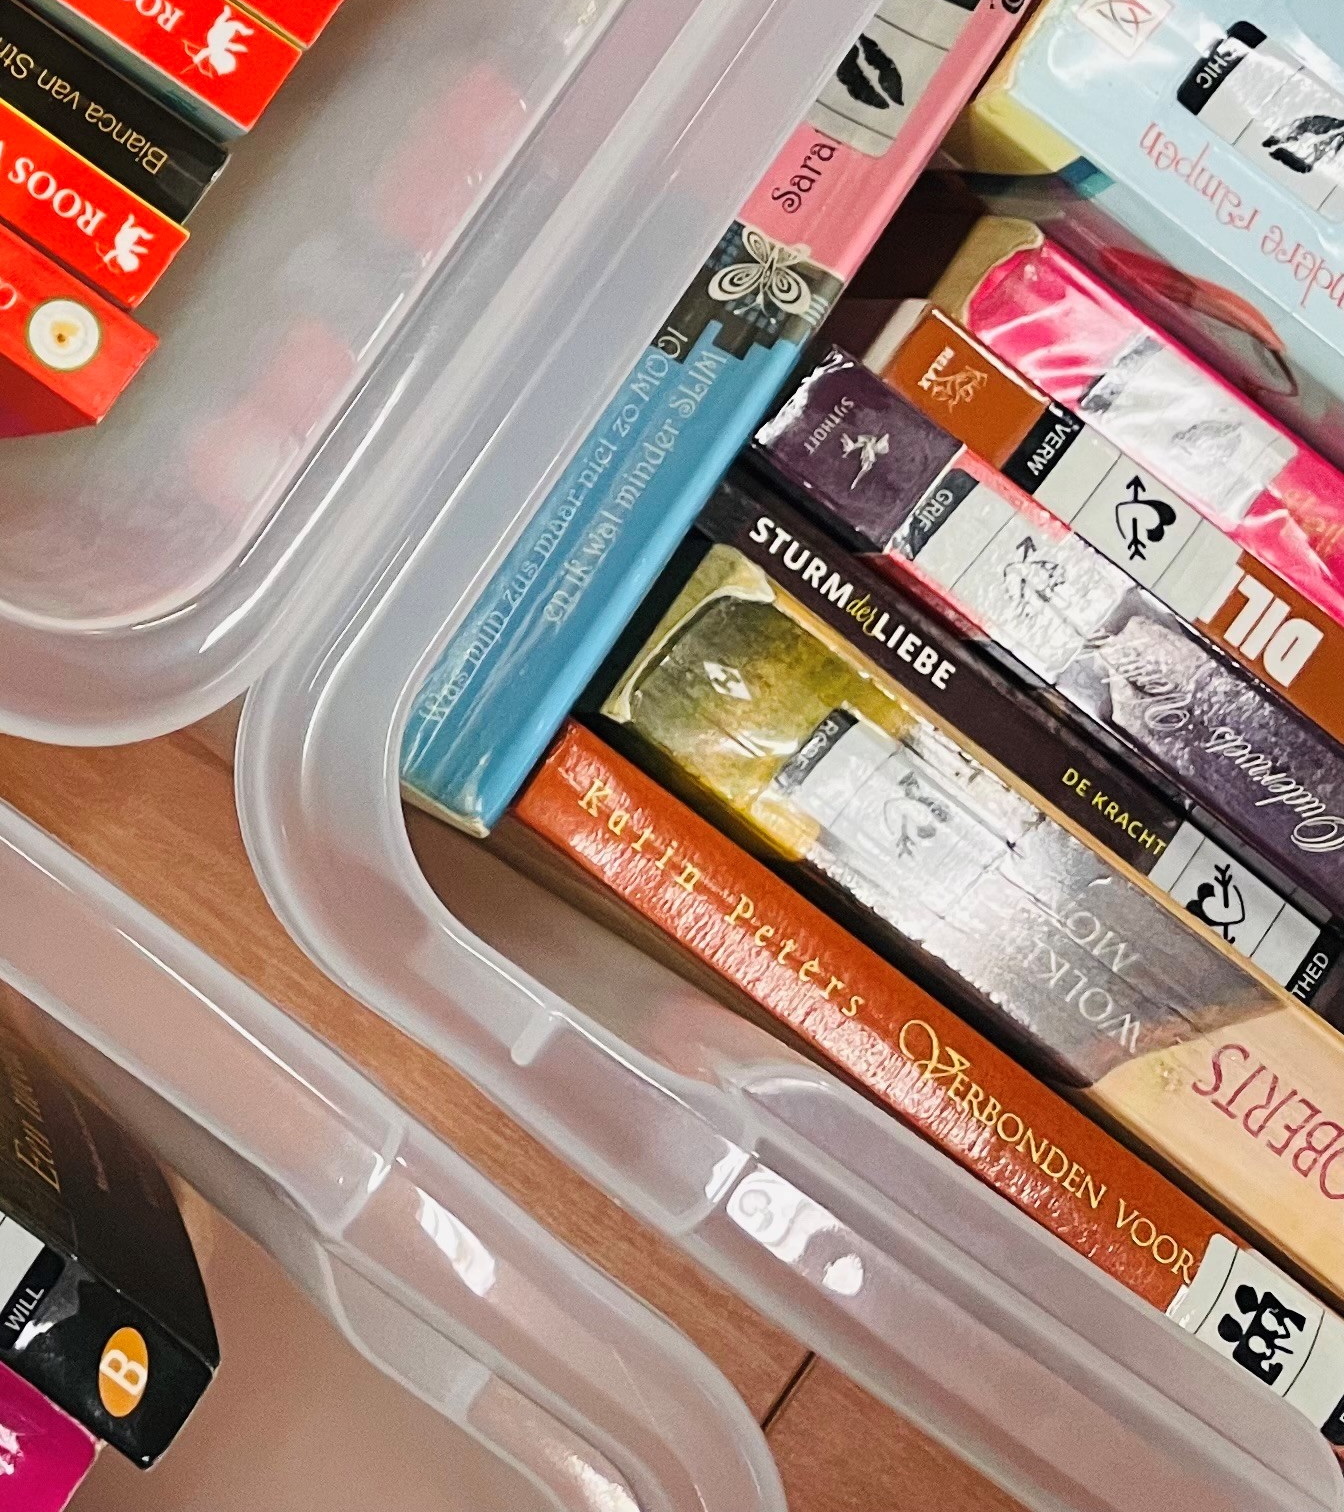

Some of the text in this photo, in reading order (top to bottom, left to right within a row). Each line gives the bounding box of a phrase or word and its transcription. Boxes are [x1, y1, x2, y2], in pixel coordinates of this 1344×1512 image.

[32, 65, 86, 112] van
[77, 98, 170, 174] Bianca
[1126, 108, 1276, 237] rampen
[6, 153, 107, 237] ROOS
[605, 413, 688, 512] minder
[1023, 418, 1073, 478] VERW
[743, 514, 962, 693] STURM LIEBE
[1059, 764, 1171, 858] DE KRACHT
[1, 1279, 47, 1335] WILL
